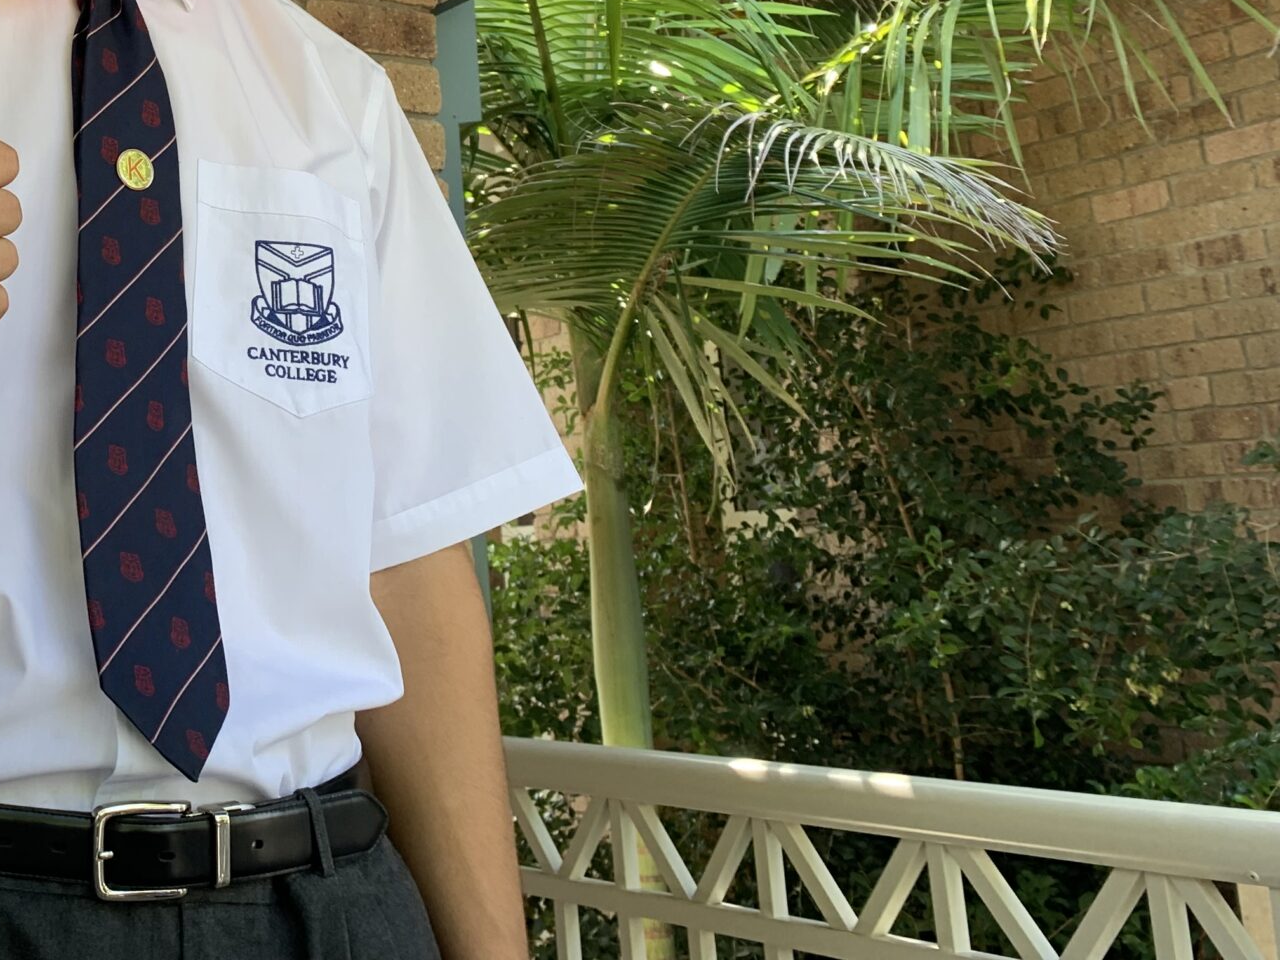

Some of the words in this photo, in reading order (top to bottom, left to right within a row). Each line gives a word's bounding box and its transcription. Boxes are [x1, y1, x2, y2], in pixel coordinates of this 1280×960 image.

[127, 156, 145, 182] K
[287, 334, 307, 343] QUO
[247, 346, 350, 369] CANTERBURY
[265, 364, 337, 383] COLLEGE
